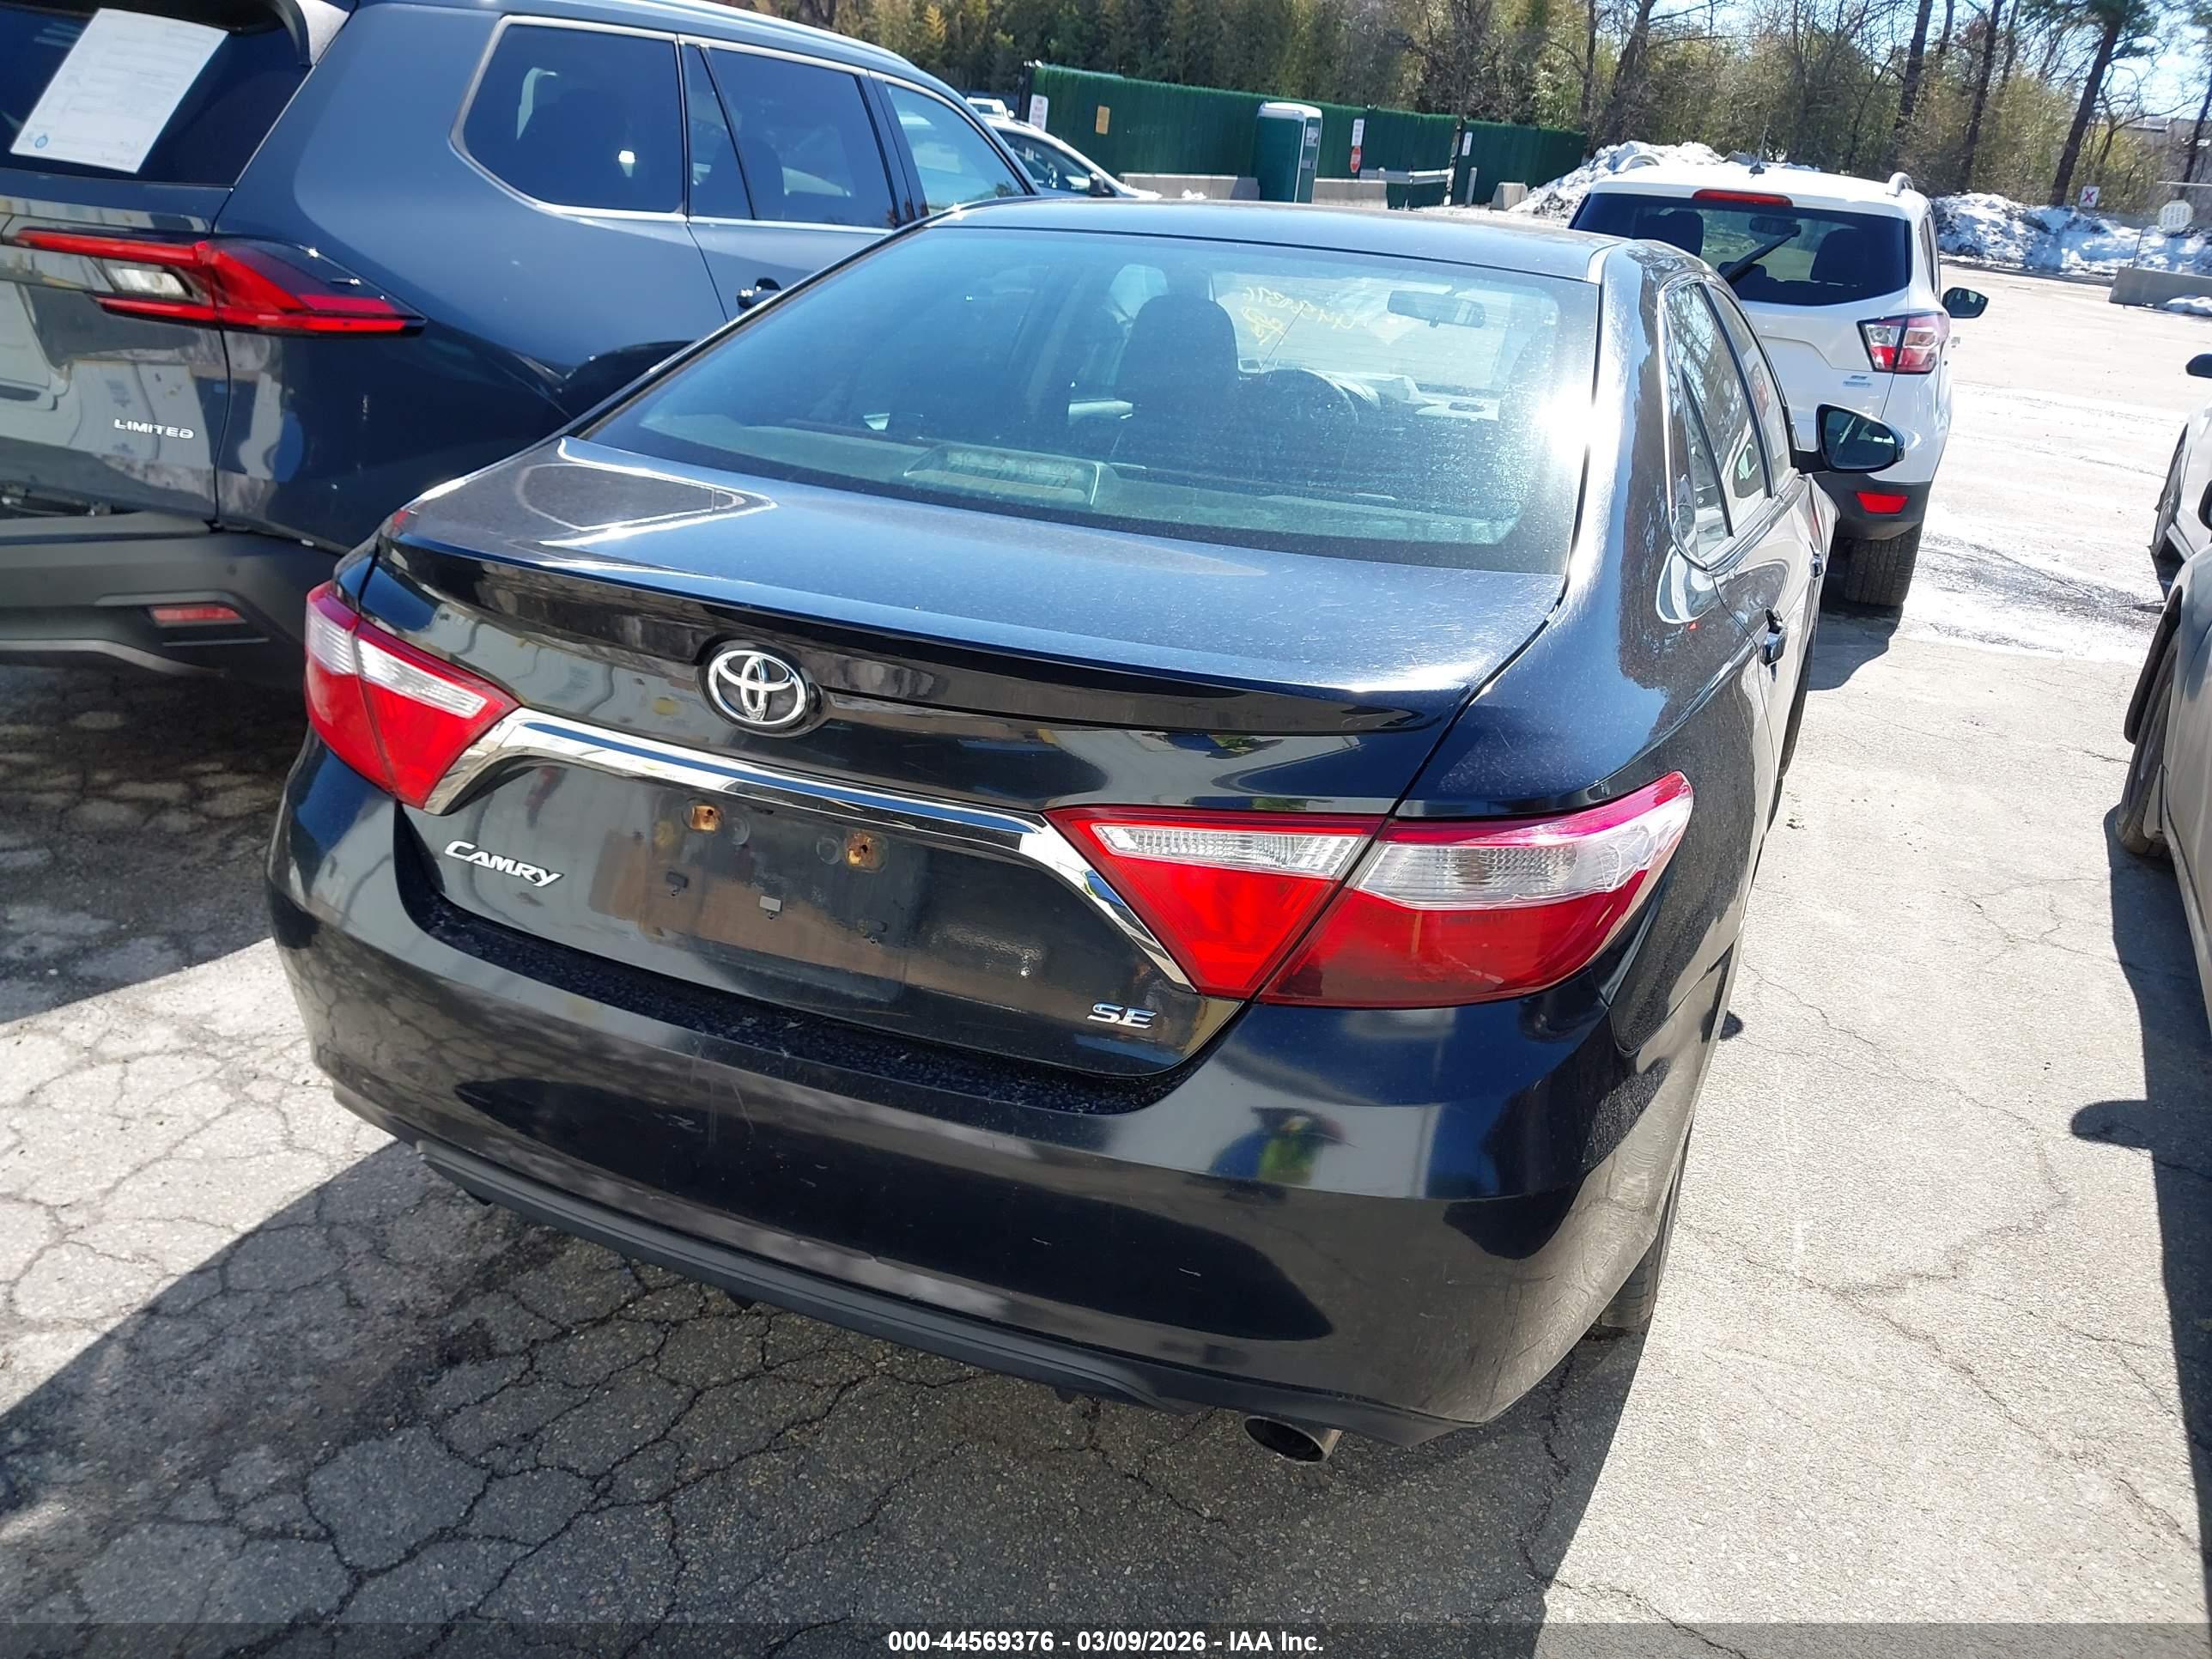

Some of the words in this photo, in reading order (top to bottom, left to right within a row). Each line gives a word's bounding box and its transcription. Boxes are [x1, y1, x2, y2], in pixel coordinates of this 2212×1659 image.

[114, 418, 194, 439] LIMITED
[444, 840, 563, 887] CAMRY
[1086, 1003, 1157, 1029] SE
